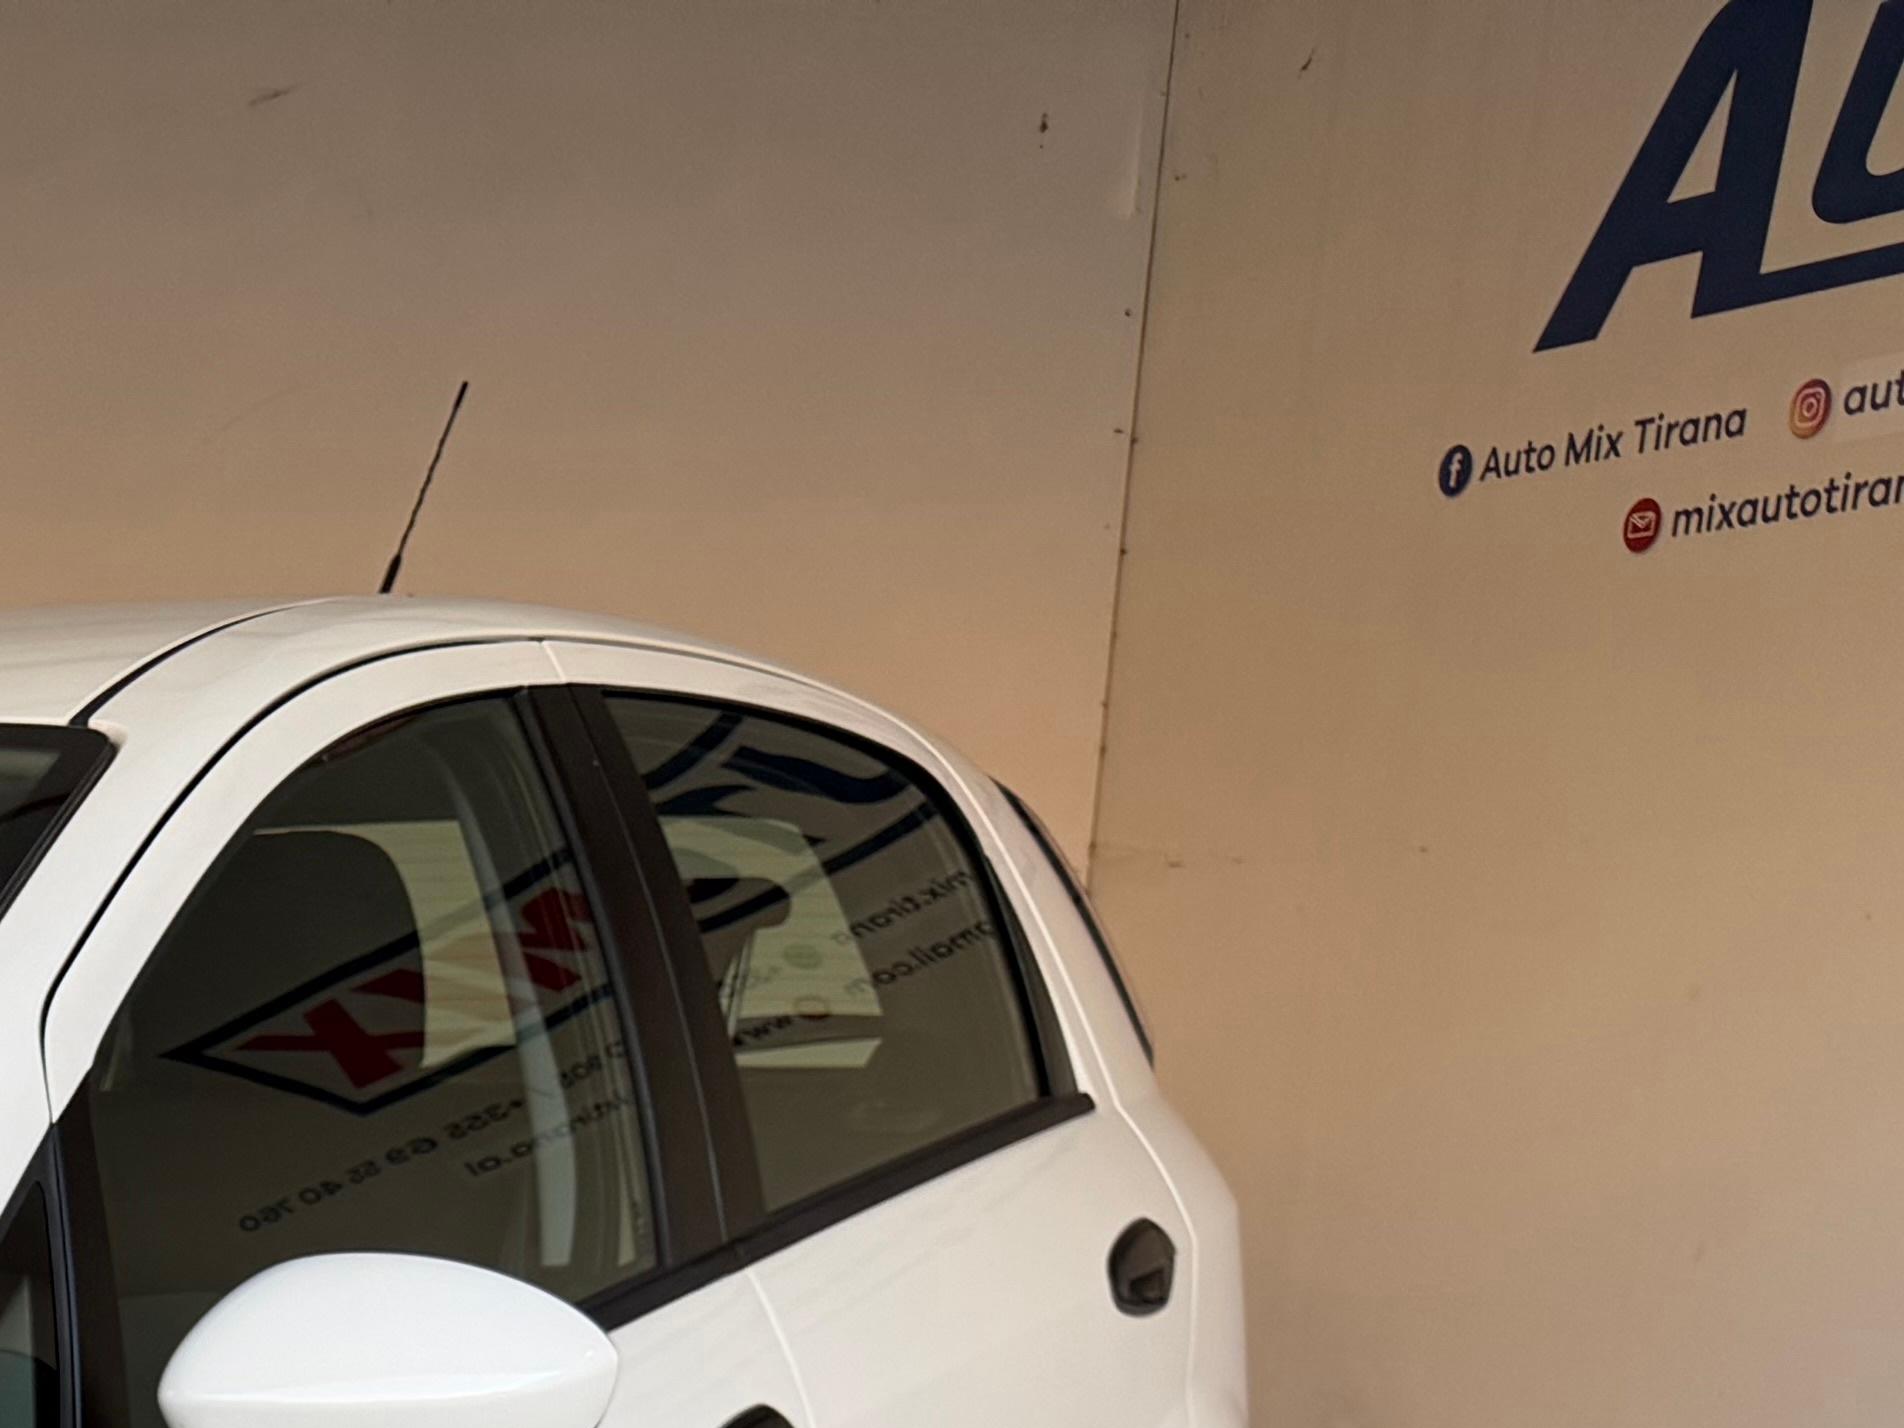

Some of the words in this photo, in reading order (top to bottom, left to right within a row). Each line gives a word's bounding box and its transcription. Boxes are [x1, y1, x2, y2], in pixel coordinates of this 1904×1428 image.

[1479, 442, 1555, 482] Auto
[1564, 424, 1623, 466] Mix
[1634, 406, 1746, 455] Tirana
